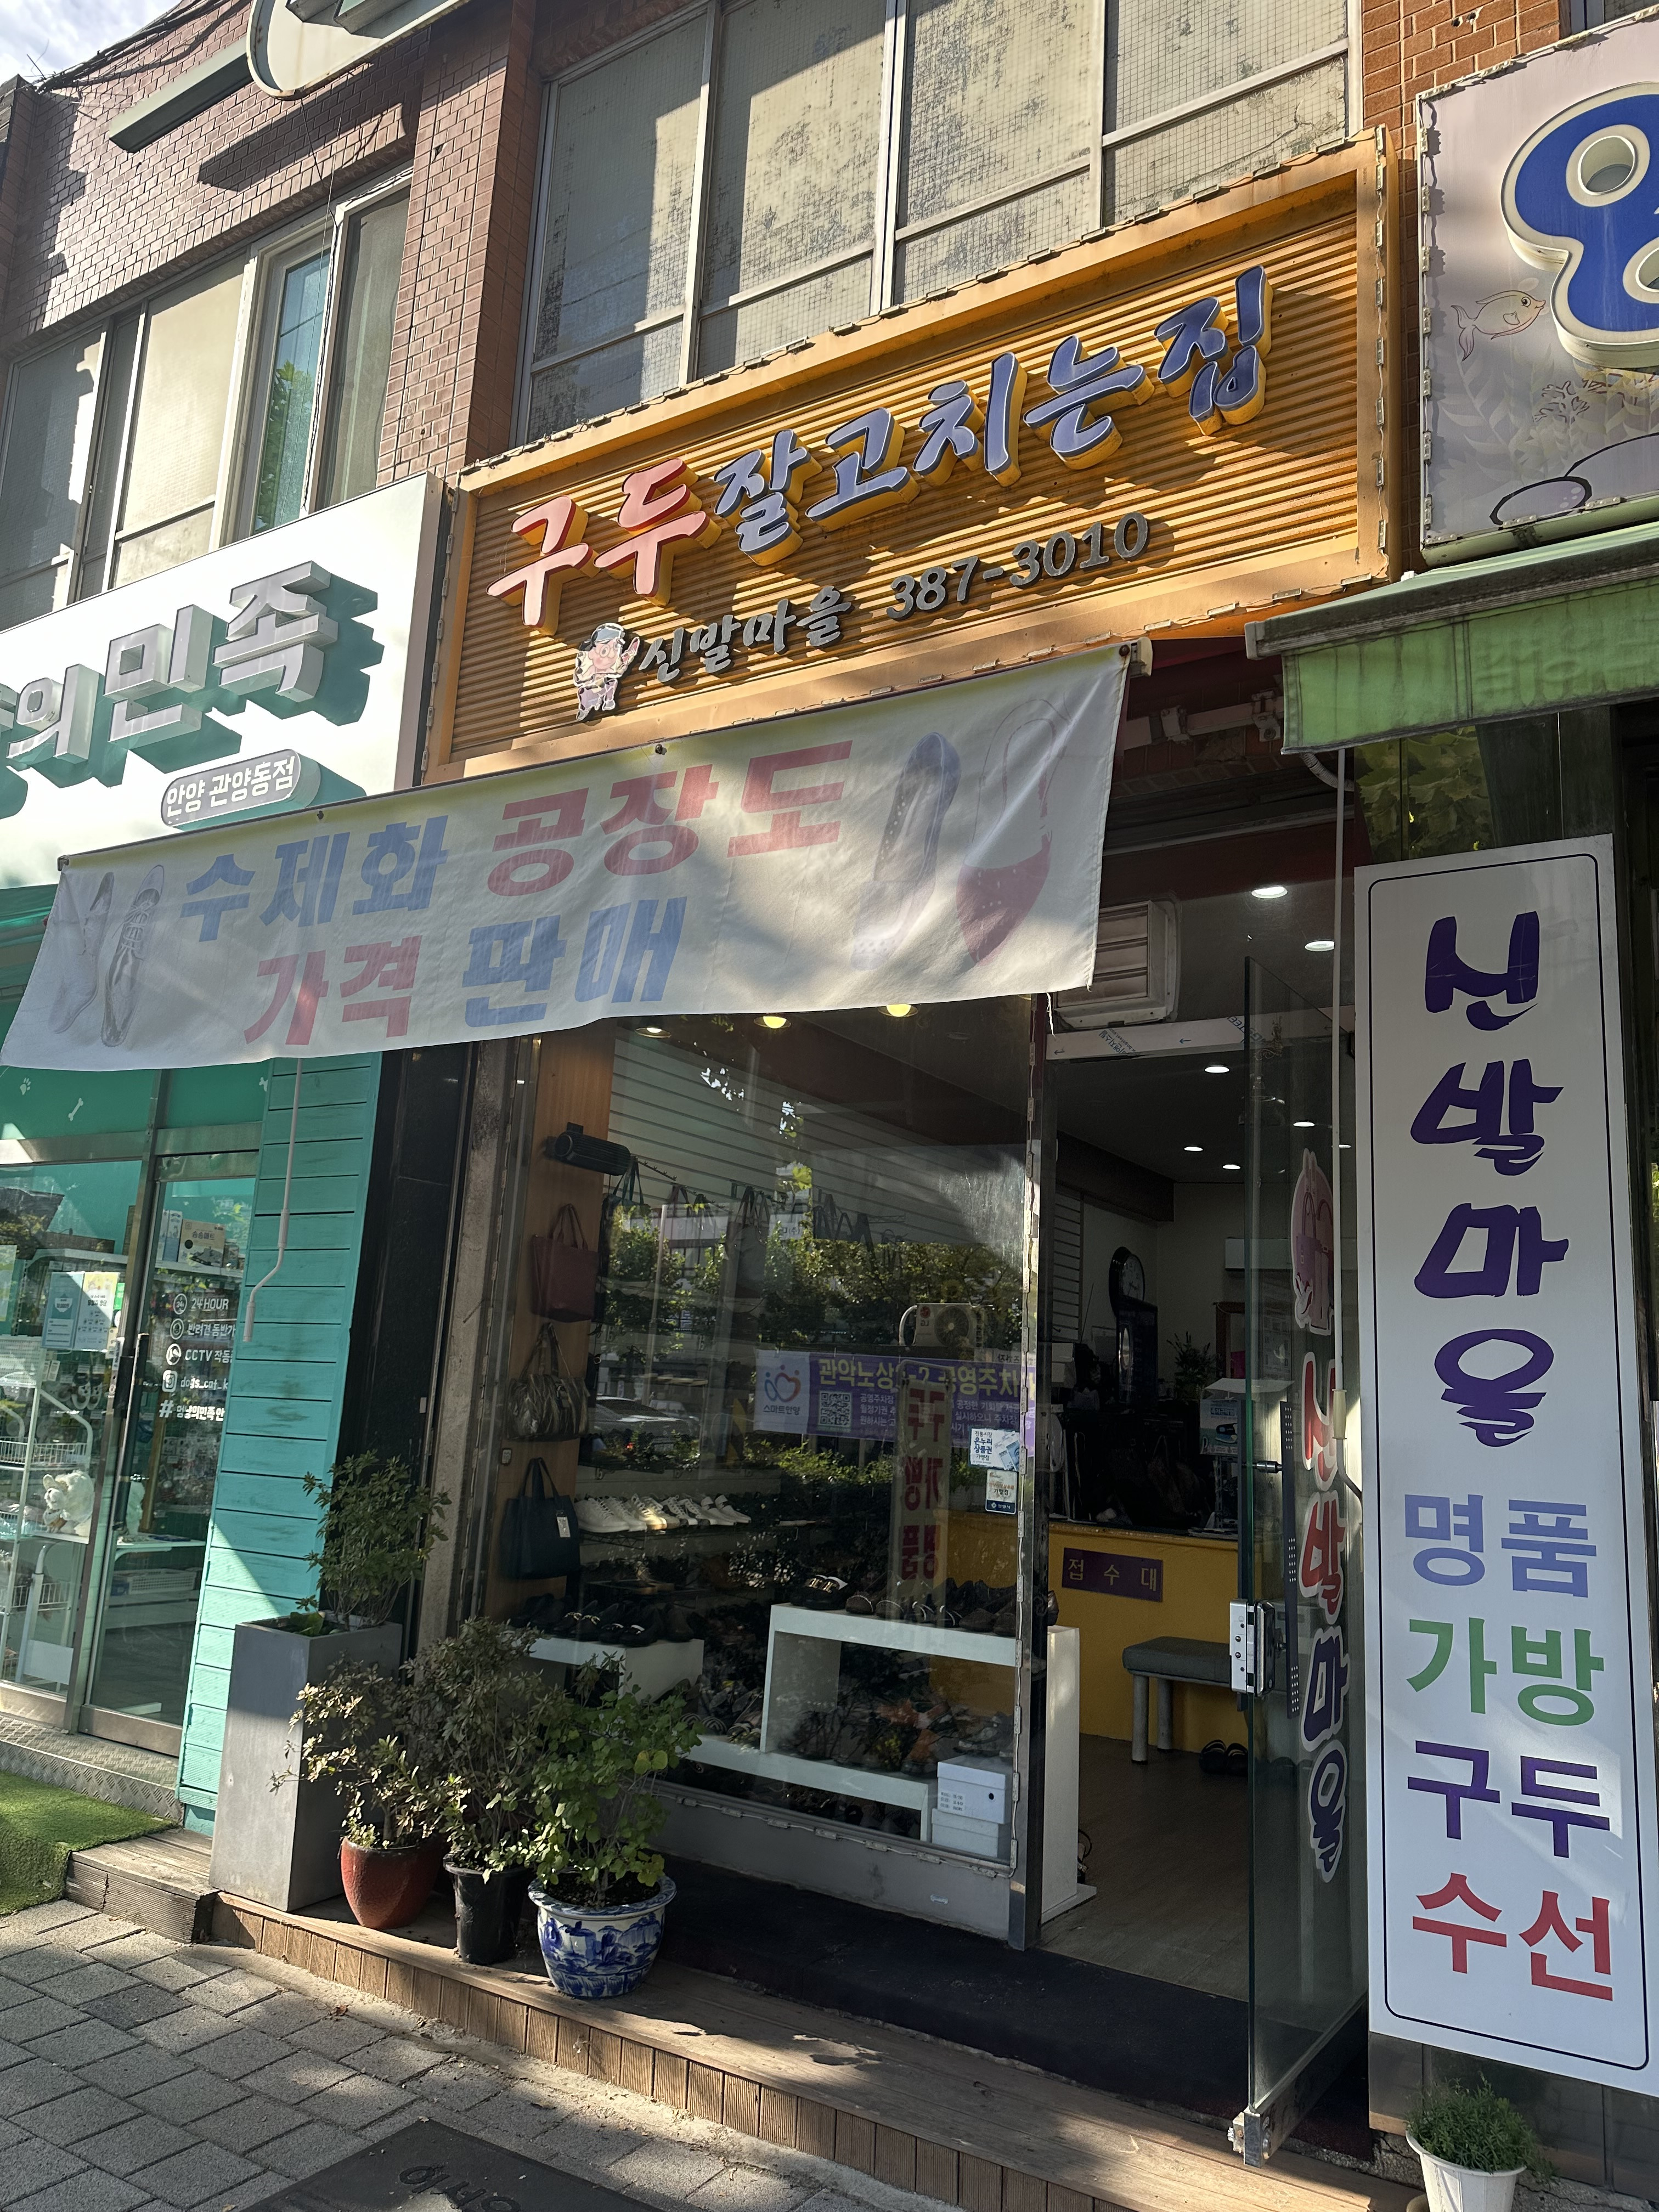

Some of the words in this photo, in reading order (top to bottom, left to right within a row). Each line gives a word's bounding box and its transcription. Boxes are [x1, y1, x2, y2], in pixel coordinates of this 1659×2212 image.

[639, 585, 853, 684] 신발마을
[886, 512, 1150, 622] 387-3010
[0, 561, 332, 760] 의민족
[166, 780, 205, 819] 안양
[209, 756, 295, 806] 관양동점
[180, 814, 449, 942] 수제화
[487, 741, 853, 896] 공장도
[244, 936, 422, 1045] 가격
[462, 896, 687, 1028] 판매
[184, 1349, 213, 1362] CCTV
[188, 1323, 211, 1336] 반려견
[763, 1404, 801, 1415] 스마트안양
[860, 1393, 894, 1404] 공영주차장
[974, 1437, 992, 1446] 온누리
[974, 1446, 992, 1454] 상품권
[1404, 1493, 1597, 1598] 명품
[1406, 1617, 1604, 1726] 가방
[1407, 1740, 1610, 1859] 구두
[1412, 1872, 1613, 2002] 수선
